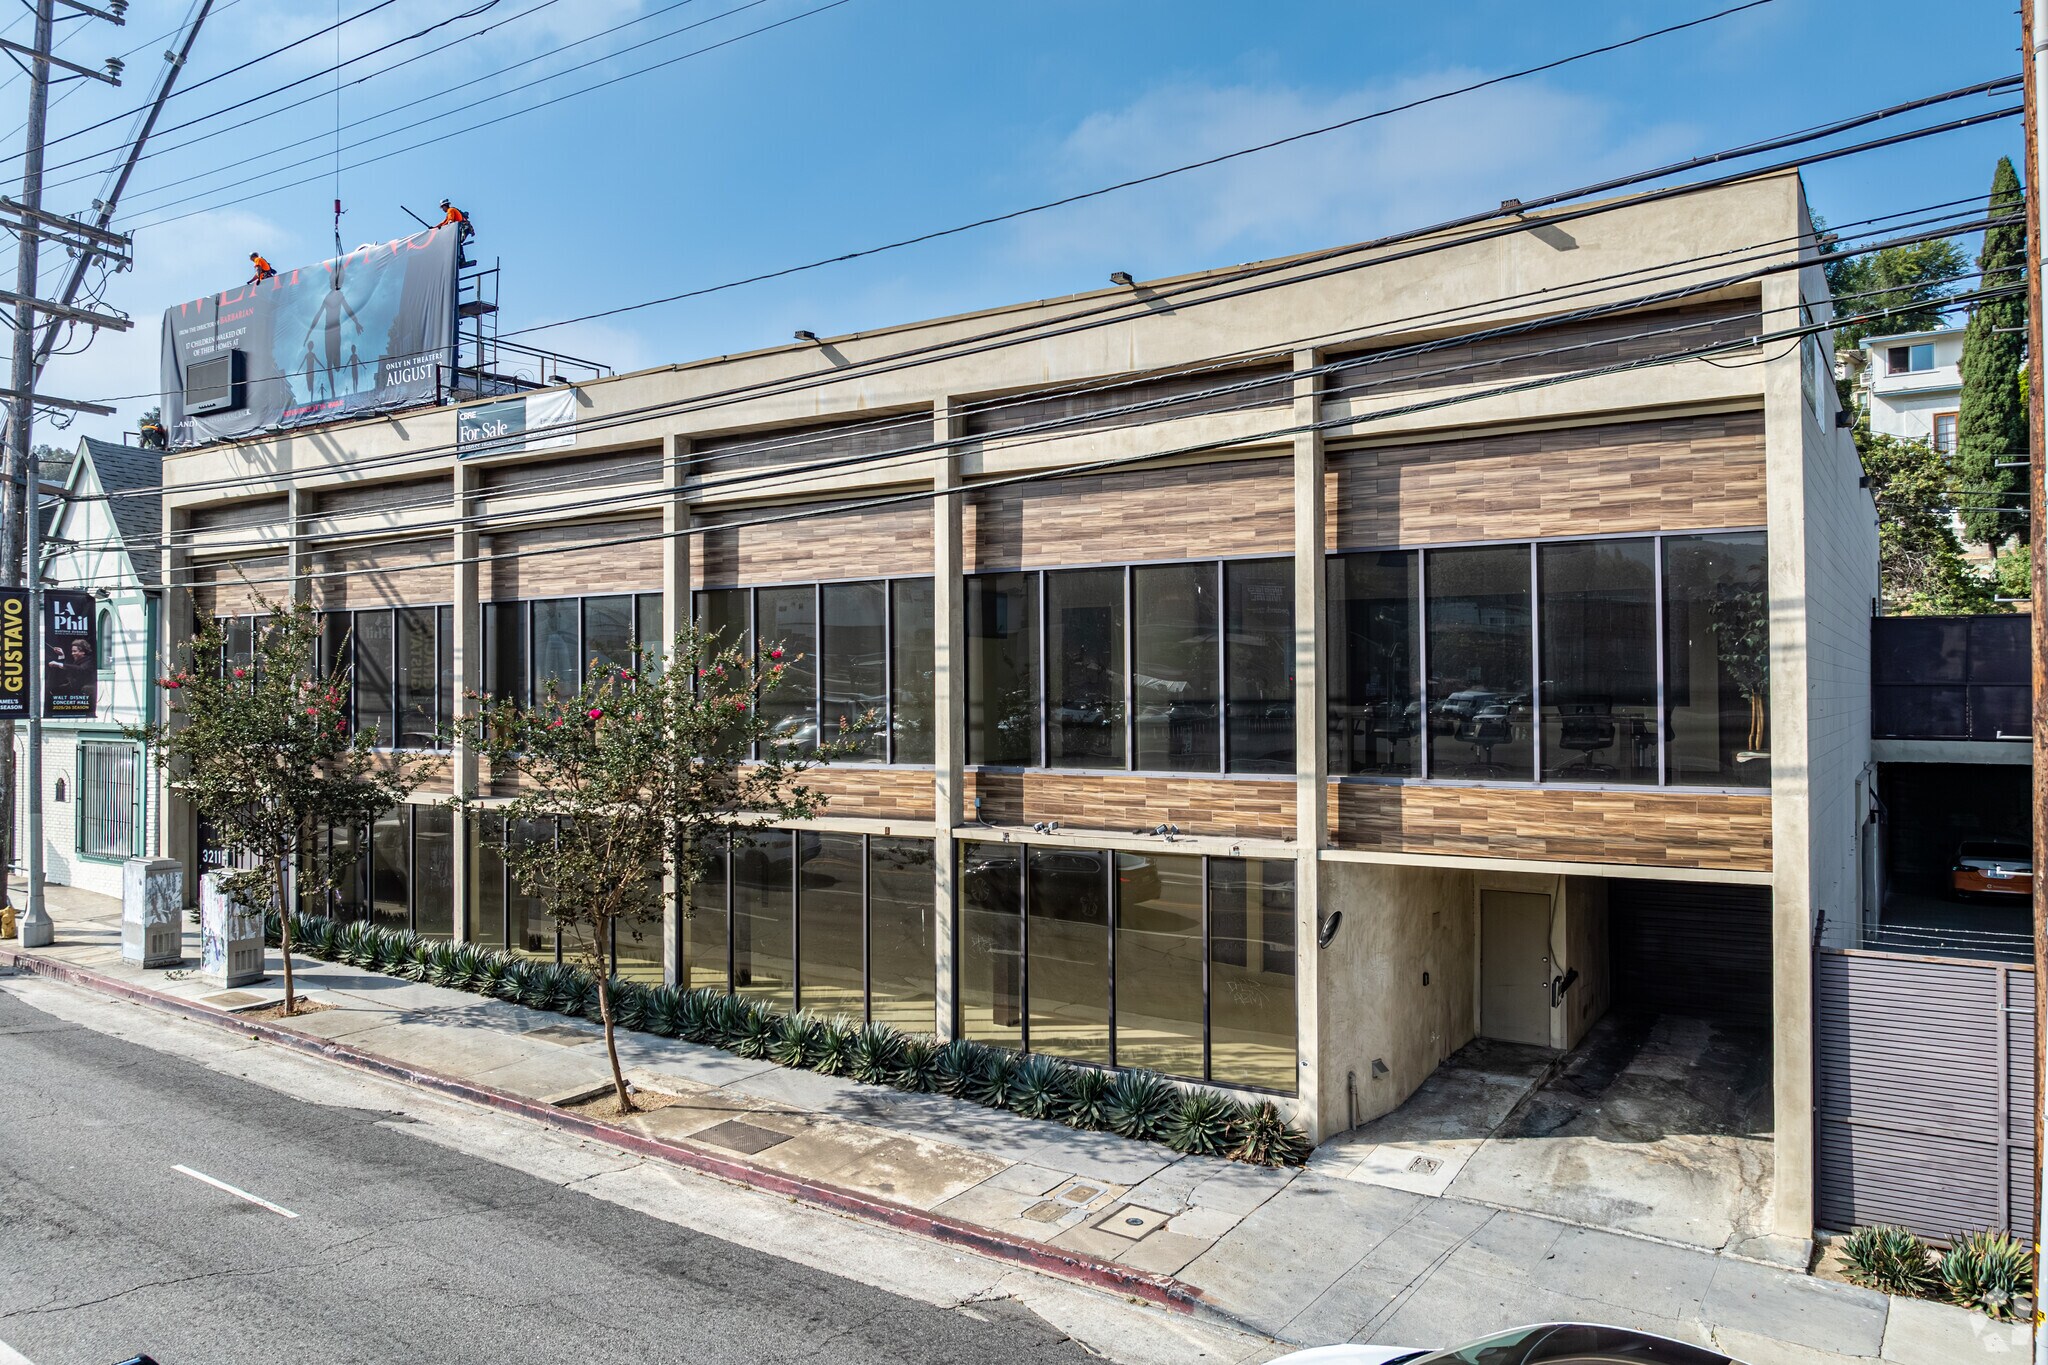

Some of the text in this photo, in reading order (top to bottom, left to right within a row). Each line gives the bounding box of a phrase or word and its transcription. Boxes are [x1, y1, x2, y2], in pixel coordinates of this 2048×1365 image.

[220, 307, 254, 324] BARBARIAN
[191, 336, 215, 348] CHILDREN
[236, 327, 247, 336] OUT
[193, 349, 200, 357] OF
[201, 345, 215, 354] THEIR
[386, 352, 443, 370] ONLY IN THEATERS
[386, 363, 433, 387] AUGUST
[460, 411, 476, 420] CBRE
[460, 419, 508, 442] For Sale
[54, 601, 75, 615] LA
[54, 616, 88, 630] Phil
[4, 598, 23, 692] GUSTAVO
[202, 849, 221, 864] 3211
